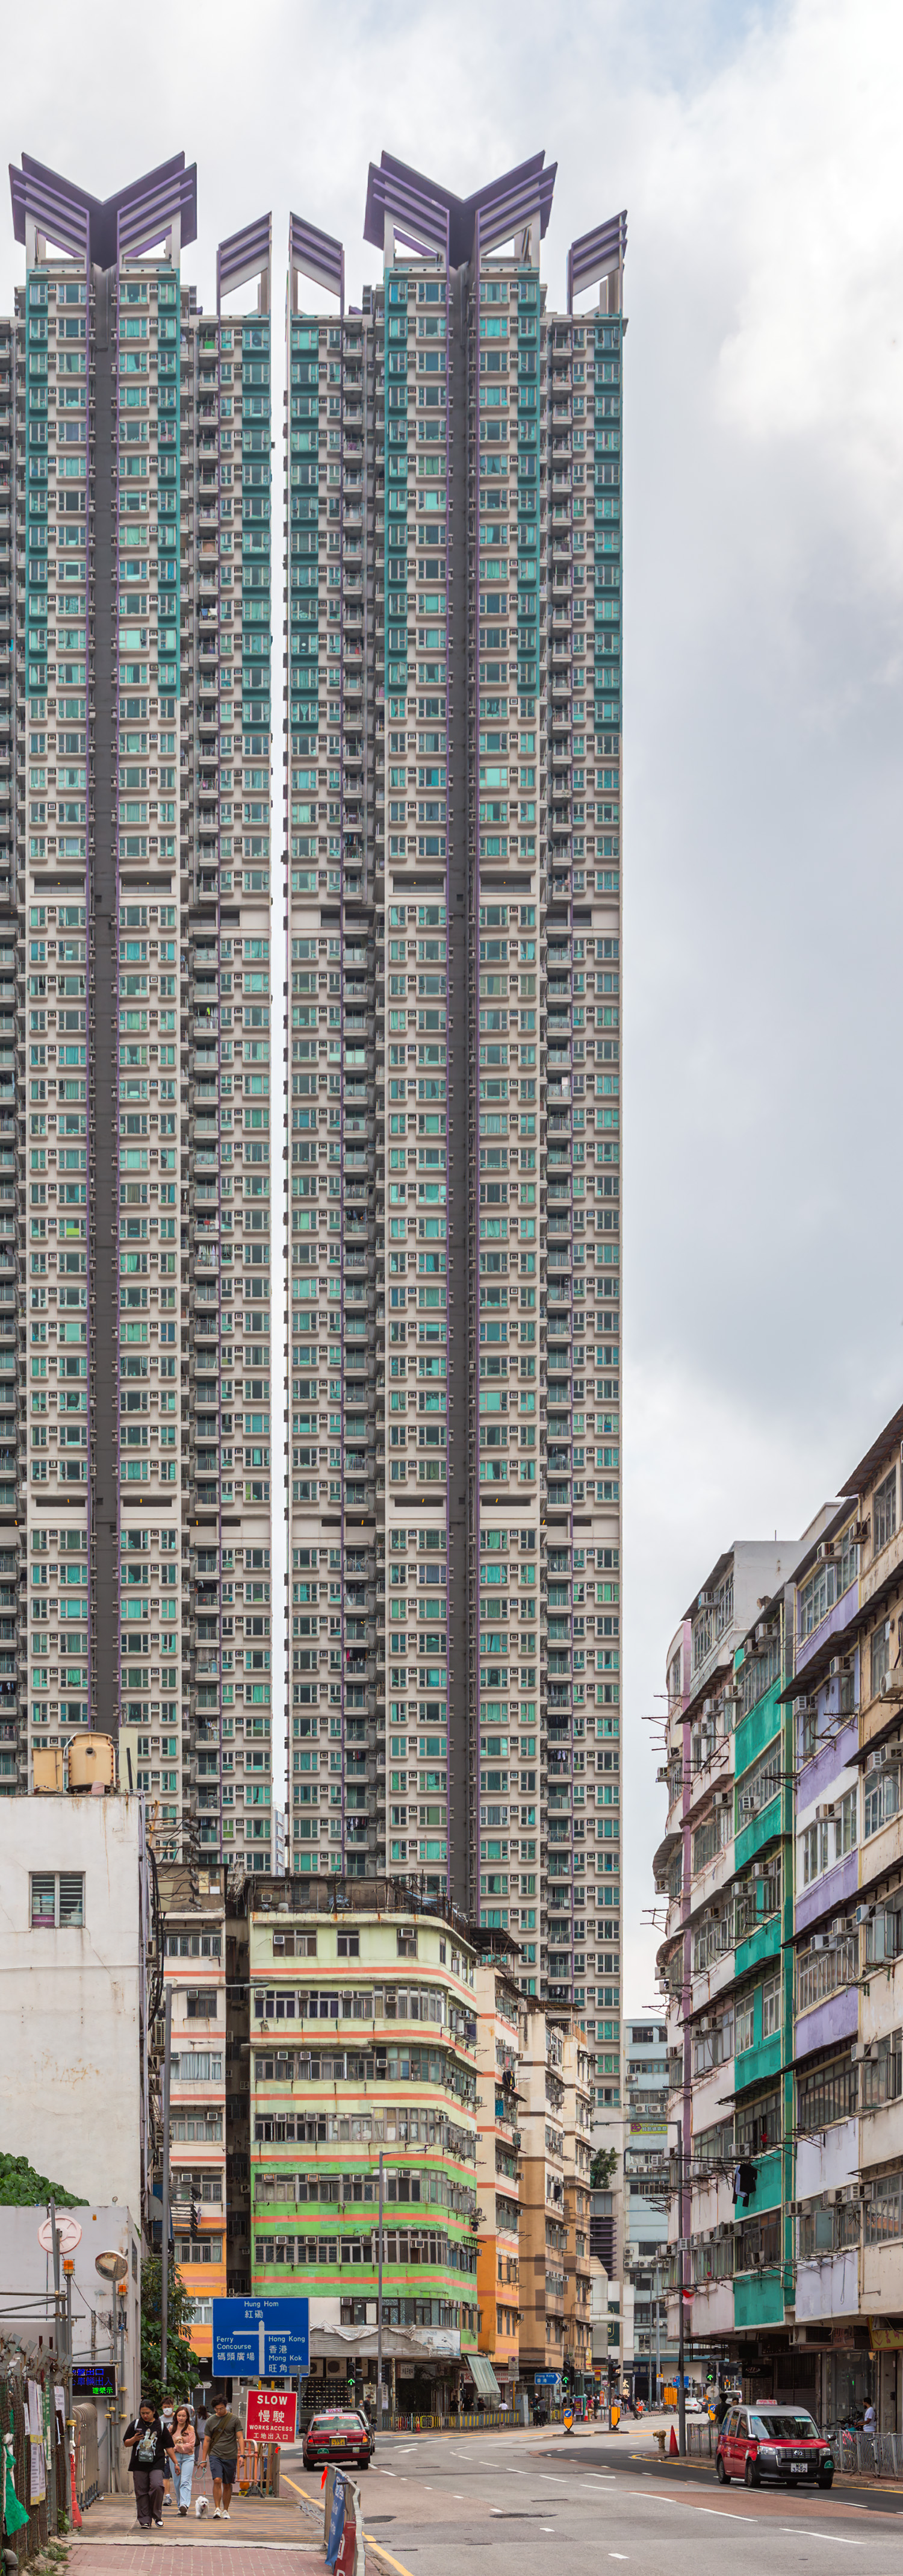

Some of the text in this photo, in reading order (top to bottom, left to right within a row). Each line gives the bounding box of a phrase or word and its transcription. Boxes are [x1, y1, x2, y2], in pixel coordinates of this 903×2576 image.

[244, 2310, 263, 2318] 紅磡
[268, 2345, 287, 2354] 香港
[217, 2353, 255, 2361] 碼頭廣場
[268, 2364, 287, 2372] 旺角
[257, 2395, 288, 2405] SLOW
[258, 2410, 285, 2423] 慢駛
